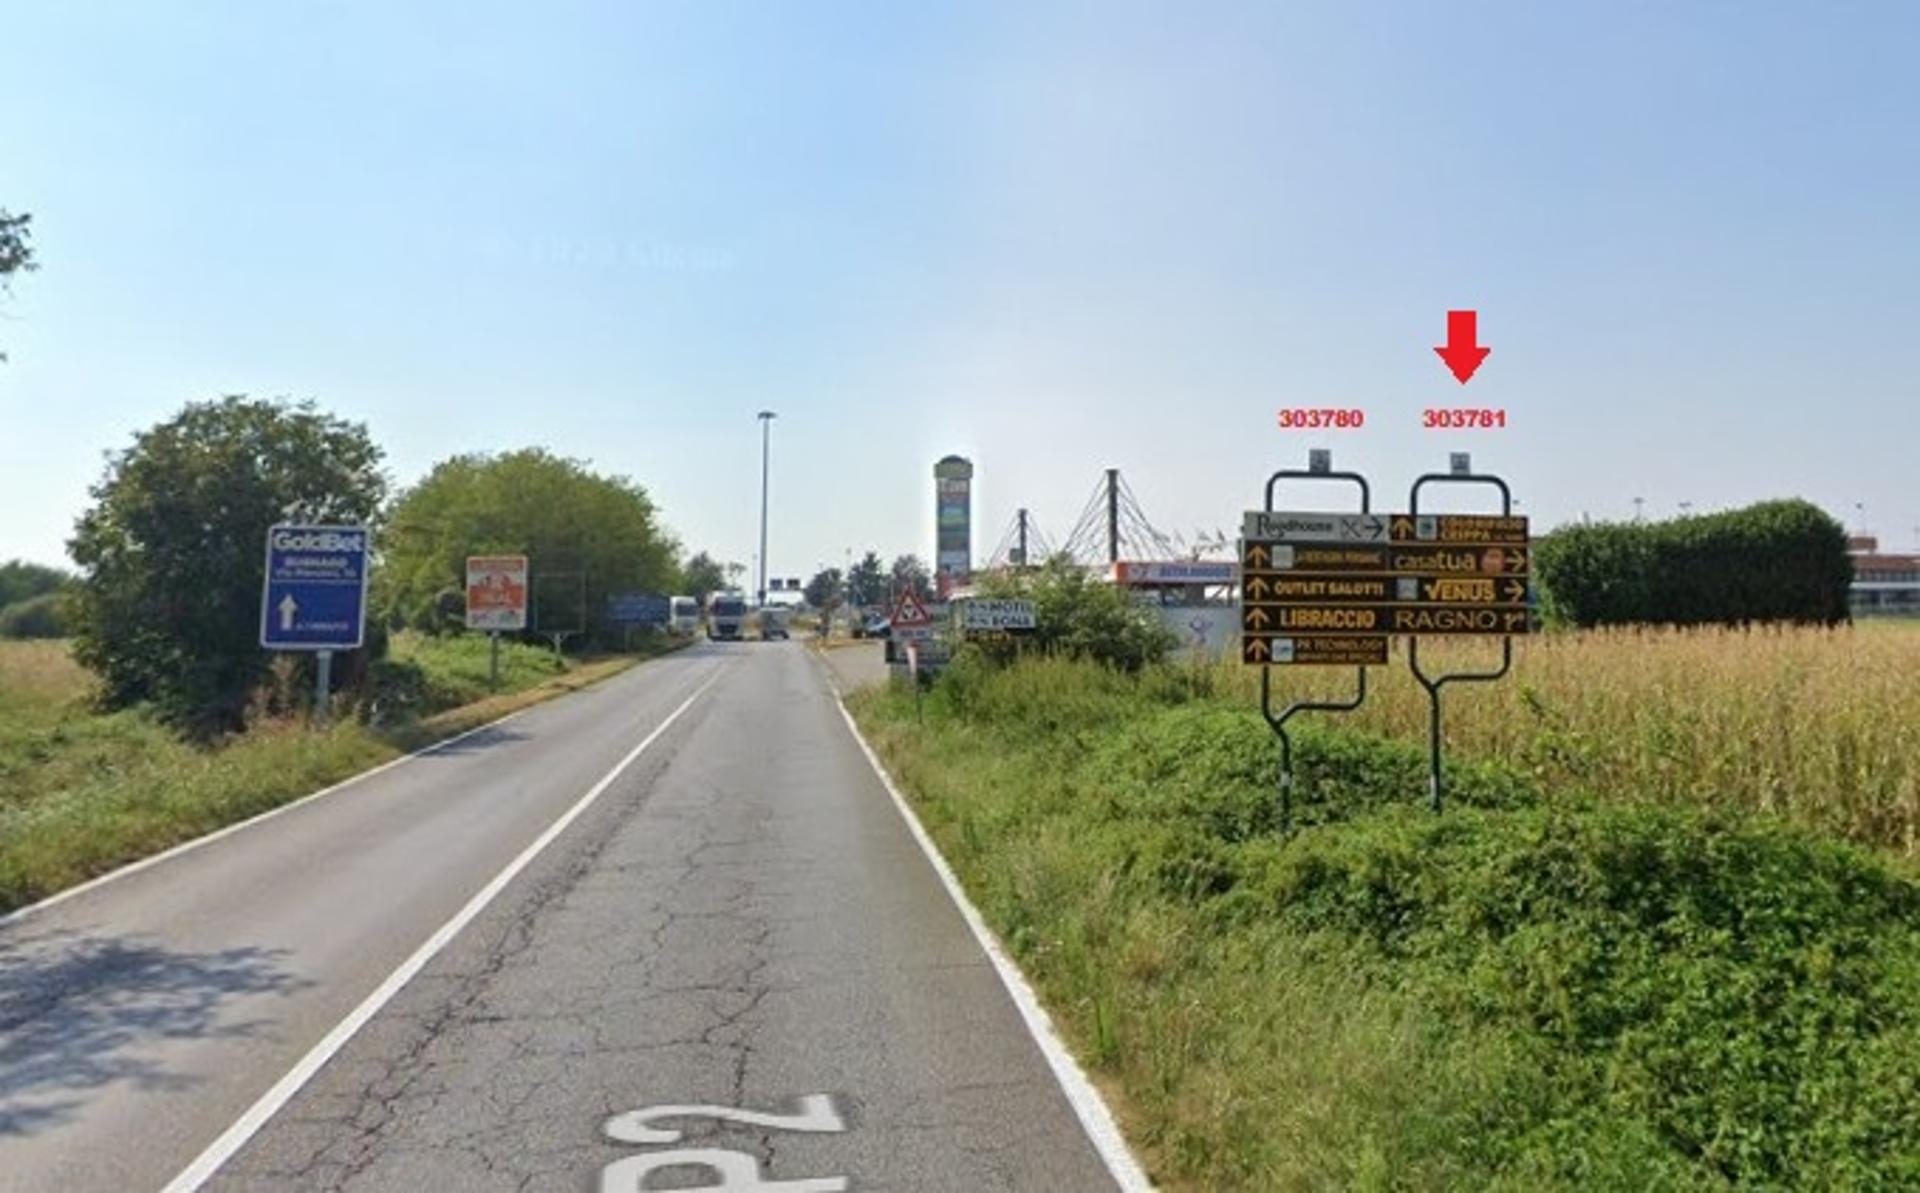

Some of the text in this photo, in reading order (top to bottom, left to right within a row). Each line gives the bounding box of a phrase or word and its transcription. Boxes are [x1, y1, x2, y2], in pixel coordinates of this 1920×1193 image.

[273, 531, 362, 553] GoldBet
[1274, 581, 1385, 596] OUTLET SALOTTI
[1424, 579, 1496, 602] VENUS
[1279, 608, 1376, 629] LIBRACCIO
[1395, 610, 1497, 630] RAGNO
